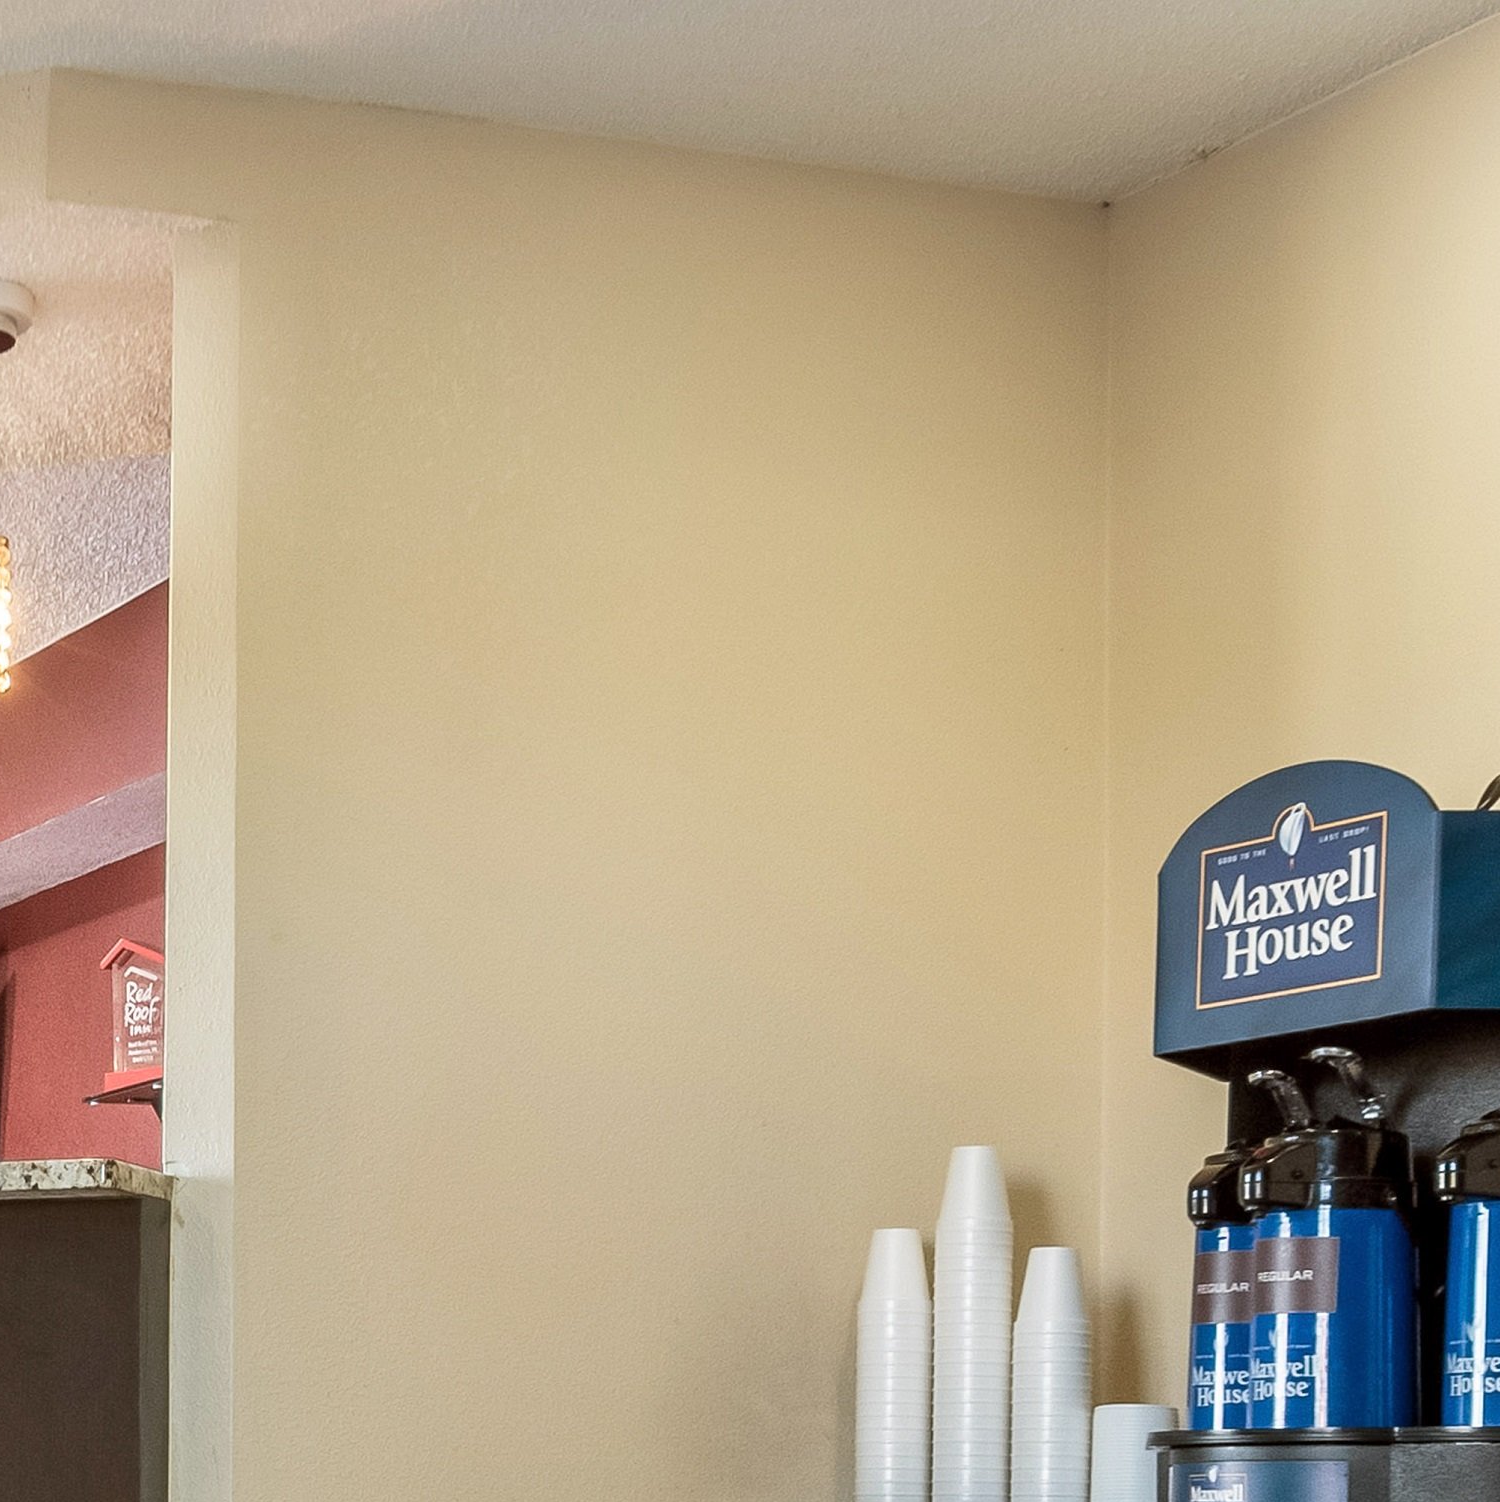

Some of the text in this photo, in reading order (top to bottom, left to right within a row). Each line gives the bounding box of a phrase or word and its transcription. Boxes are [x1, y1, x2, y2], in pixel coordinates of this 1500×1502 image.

[1205, 844, 1378, 931] Maxwell
[1222, 913, 1355, 981] House
[125, 980, 154, 1004] Red
[124, 995, 161, 1028] Roof
[1257, 1269, 1315, 1282] REGULAR
[1197, 1282, 1251, 1295] REGULAR
[1252, 1380, 1310, 1402] Hose
[1190, 1483, 1244, 1502] Maxwell
